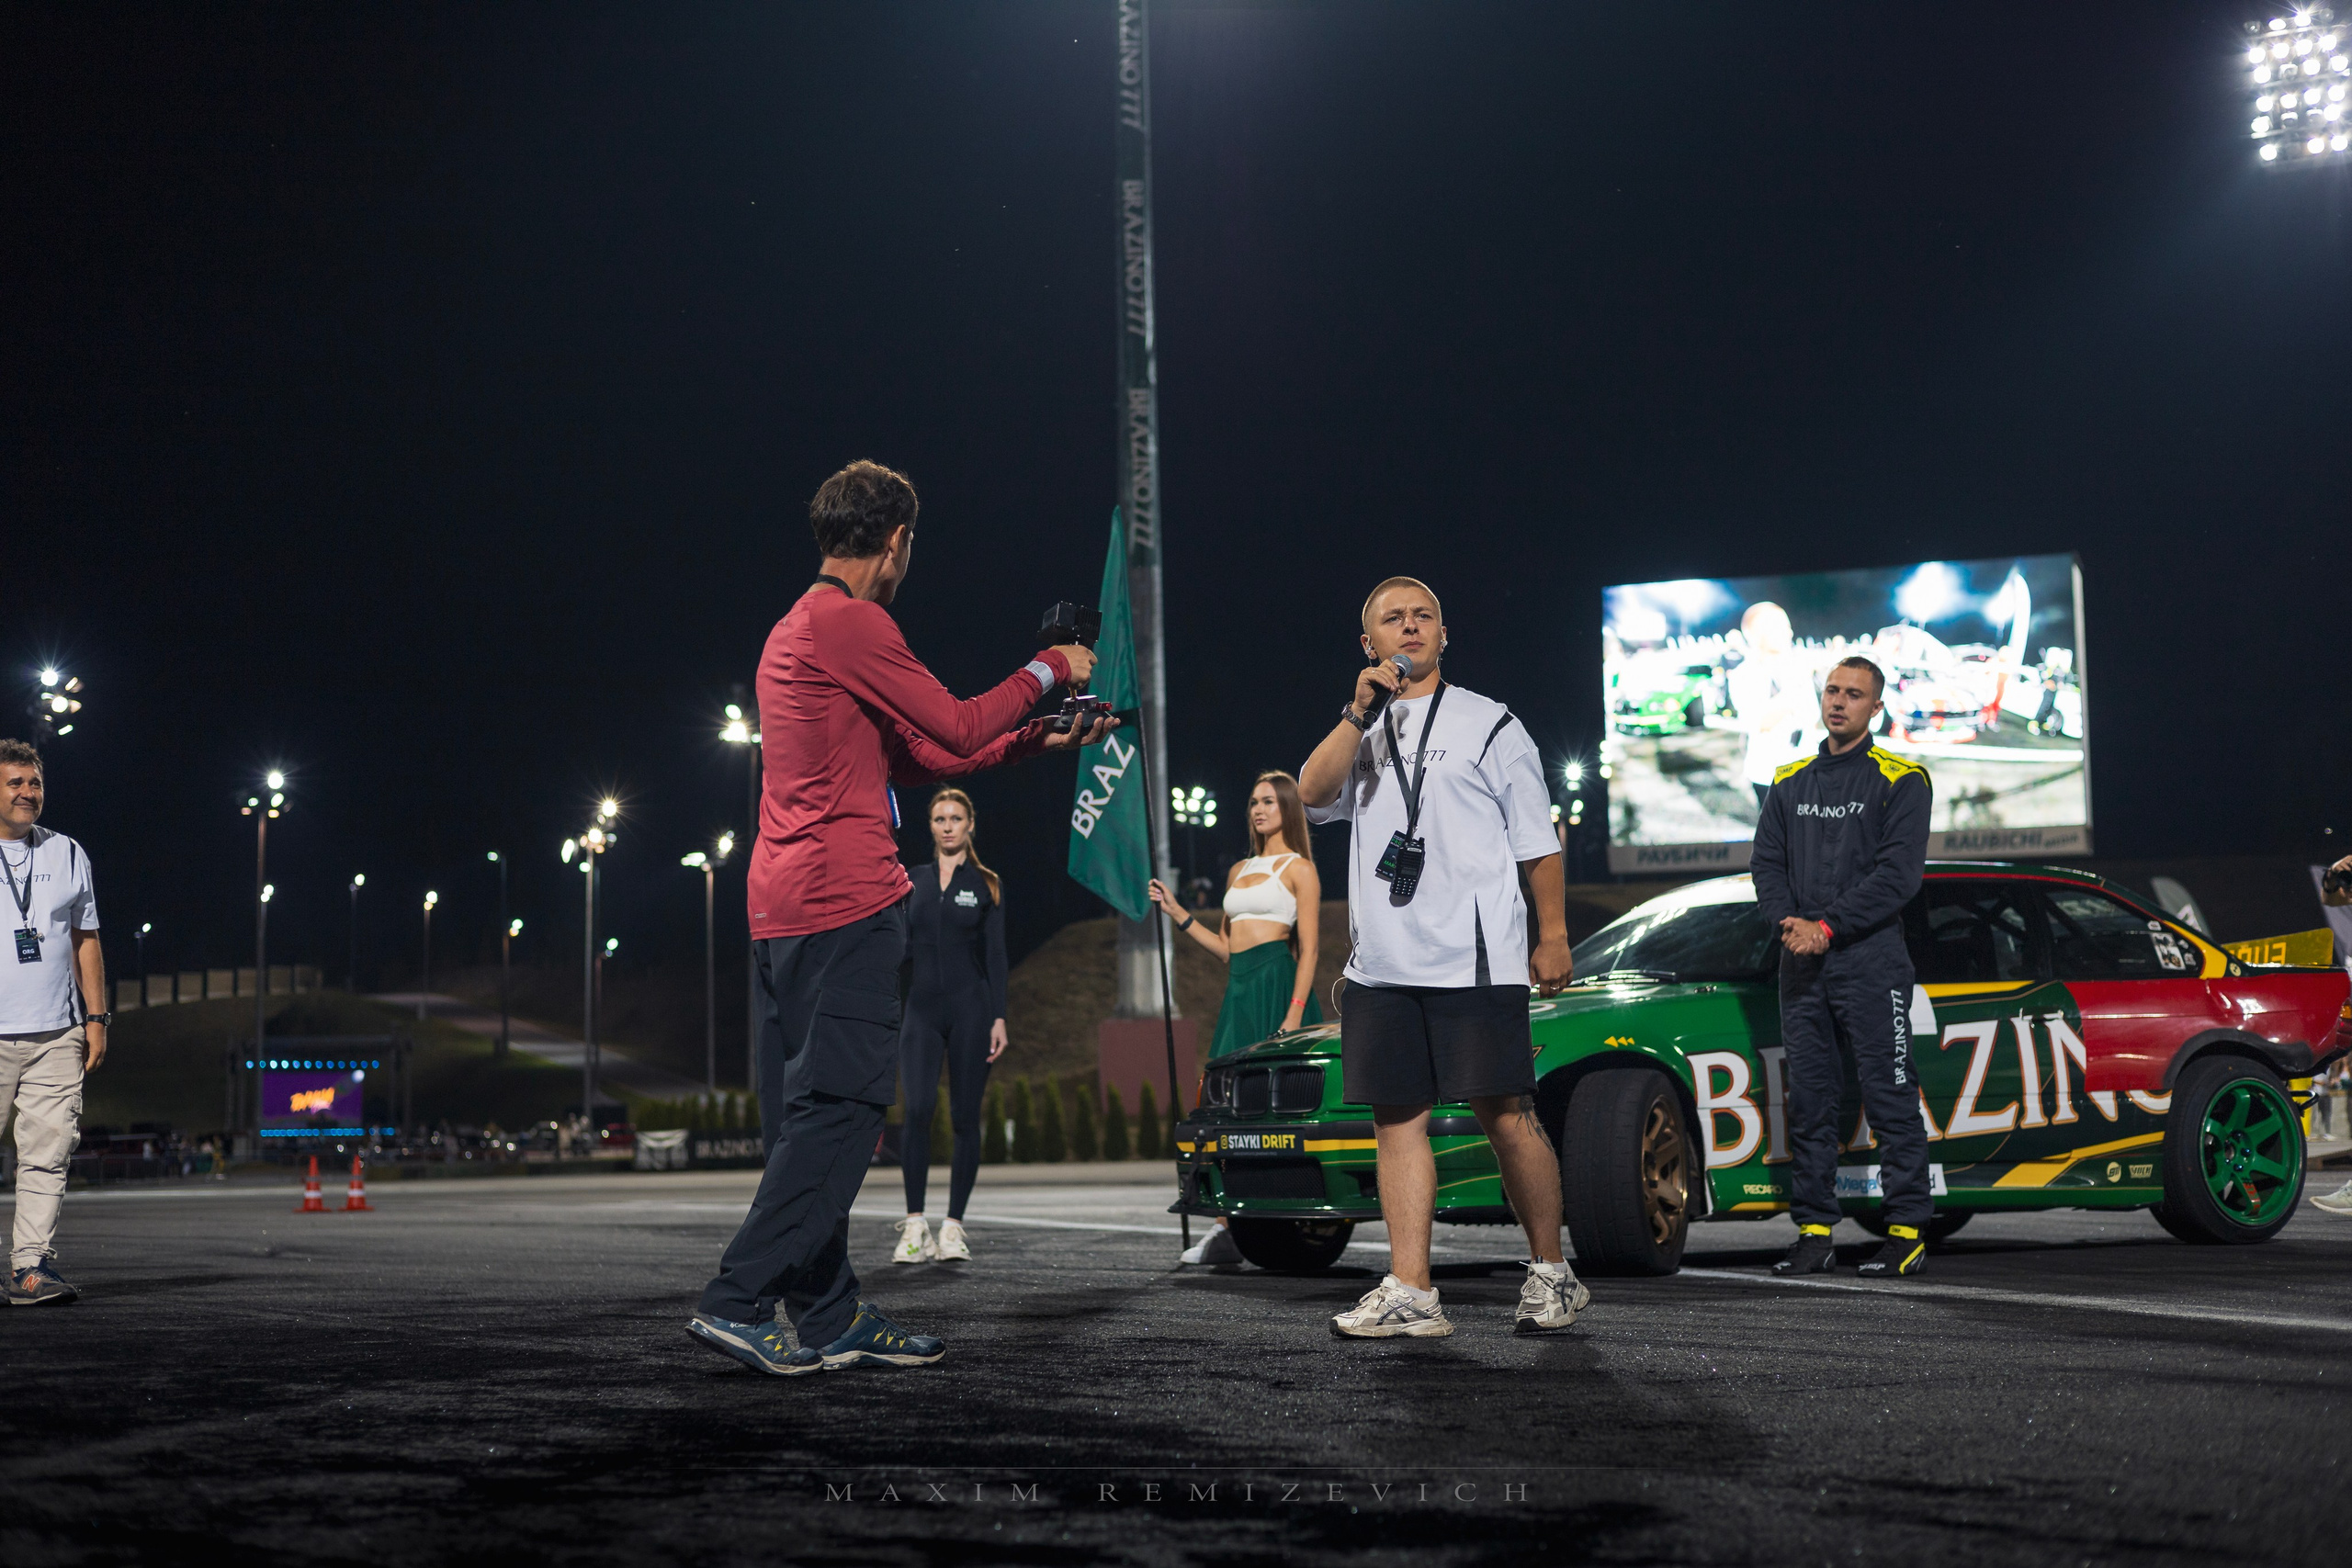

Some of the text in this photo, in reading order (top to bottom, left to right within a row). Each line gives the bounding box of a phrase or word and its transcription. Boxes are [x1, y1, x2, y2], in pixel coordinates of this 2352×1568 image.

[1071, 733, 1136, 840] BRAZ
[1891, 989, 1906, 1086] BRAZINO777
[1228, 1134, 1295, 1149] STAYKI DRIFT
[1742, 1184, 1783, 1195] RECARO
